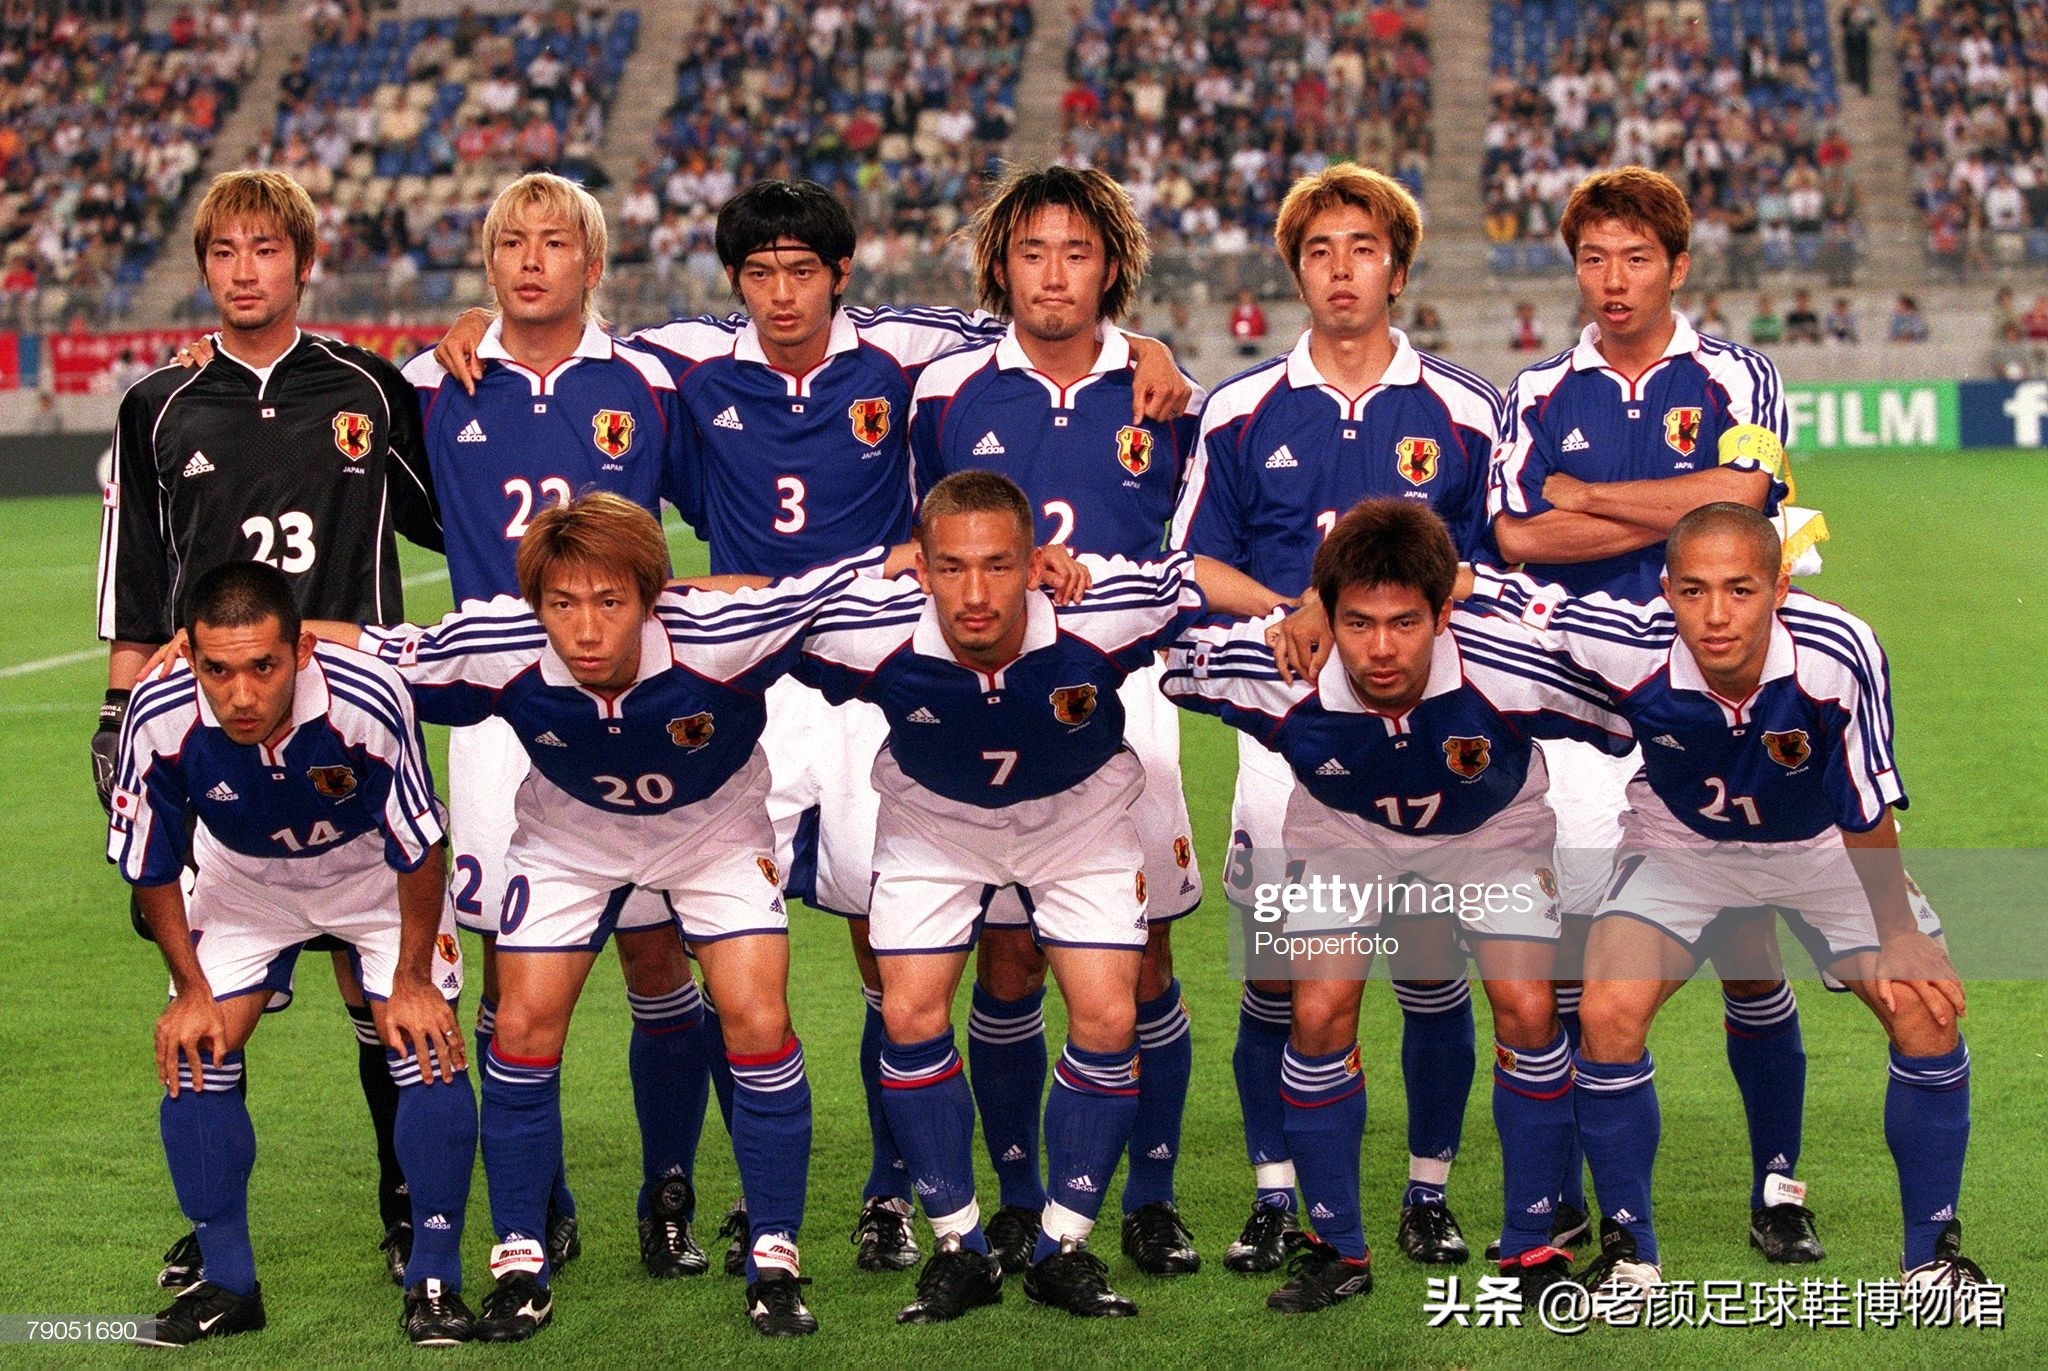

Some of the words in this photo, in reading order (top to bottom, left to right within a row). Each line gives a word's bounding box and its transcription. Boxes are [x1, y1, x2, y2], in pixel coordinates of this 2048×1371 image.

[713, 418, 743, 430] adidas
[1785, 391, 1936, 447] FILM
[457, 433, 487, 443] adidas
[972, 445, 1005, 455] adidas
[1561, 441, 1589, 452] adidas
[601, 463, 623, 471] JAPAN
[1265, 458, 1298, 468] adidas
[183, 464, 215, 477] adidas
[343, 466, 365, 474] JAPAN
[1404, 491, 1428, 499] JAPAN
[774, 475, 806, 534] 3
[1042, 498, 1076, 558] 2
[241, 510, 316, 573] 23
[906, 716, 941, 724] adidas
[982, 750, 1020, 786] 7
[592, 773, 675, 807] 20
[206, 792, 239, 801] adidas
[1698, 776, 1763, 825] 21
[1374, 791, 1442, 829] 17
[270, 820, 343, 852] 14
[456, 854, 483, 916] 2
[500, 874, 531, 936] 0
[1067, 1181, 1098, 1192] adidas
[424, 1221, 451, 1230] adidas
